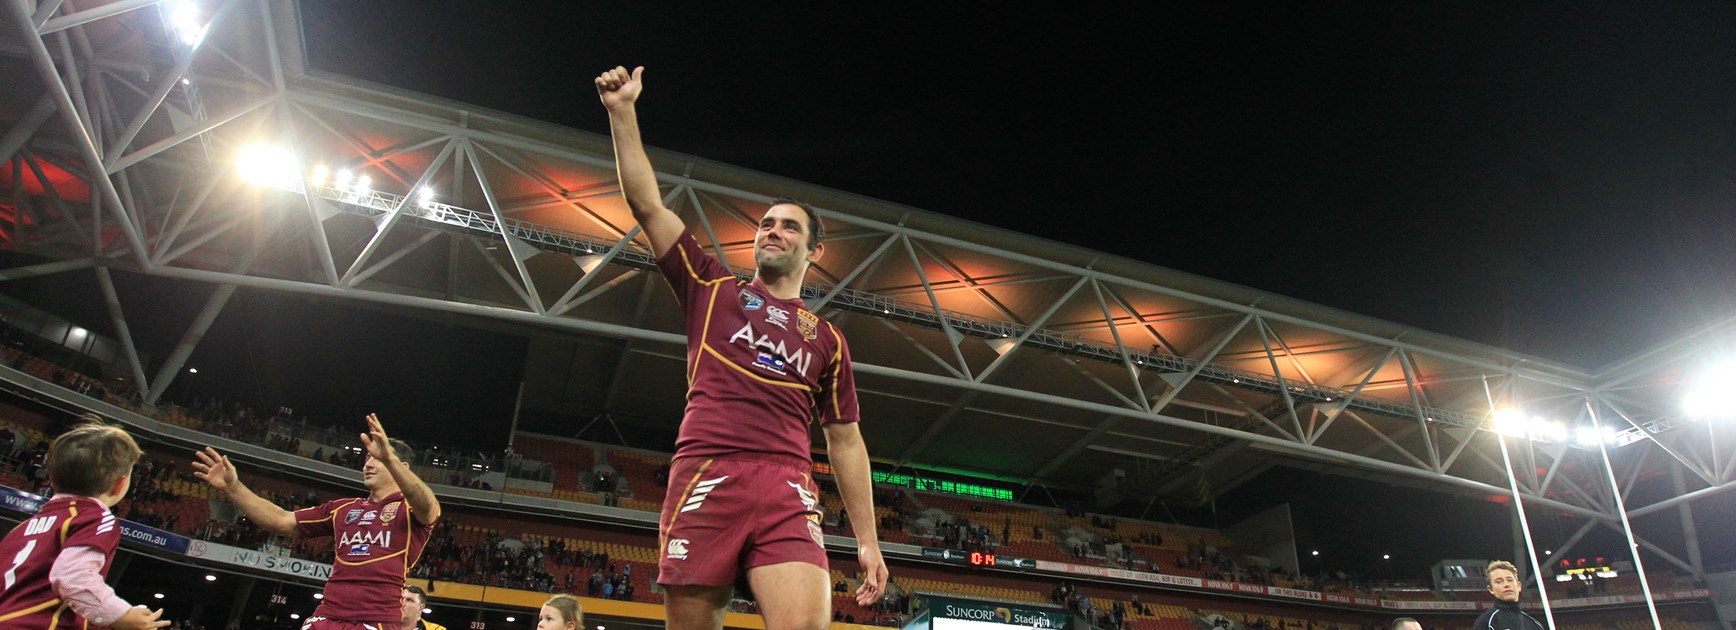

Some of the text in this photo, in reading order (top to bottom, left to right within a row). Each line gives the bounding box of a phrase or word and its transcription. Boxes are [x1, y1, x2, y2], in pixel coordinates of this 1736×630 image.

[729, 320, 812, 377] AAMI
[23, 515, 58, 536] DAD
[338, 530, 392, 549] AAMI
[234, 551, 260, 566] NO
[271, 594, 287, 604] 314
[470, 621, 486, 630] 313
[946, 605, 1050, 628] SUNCORP Stadium
